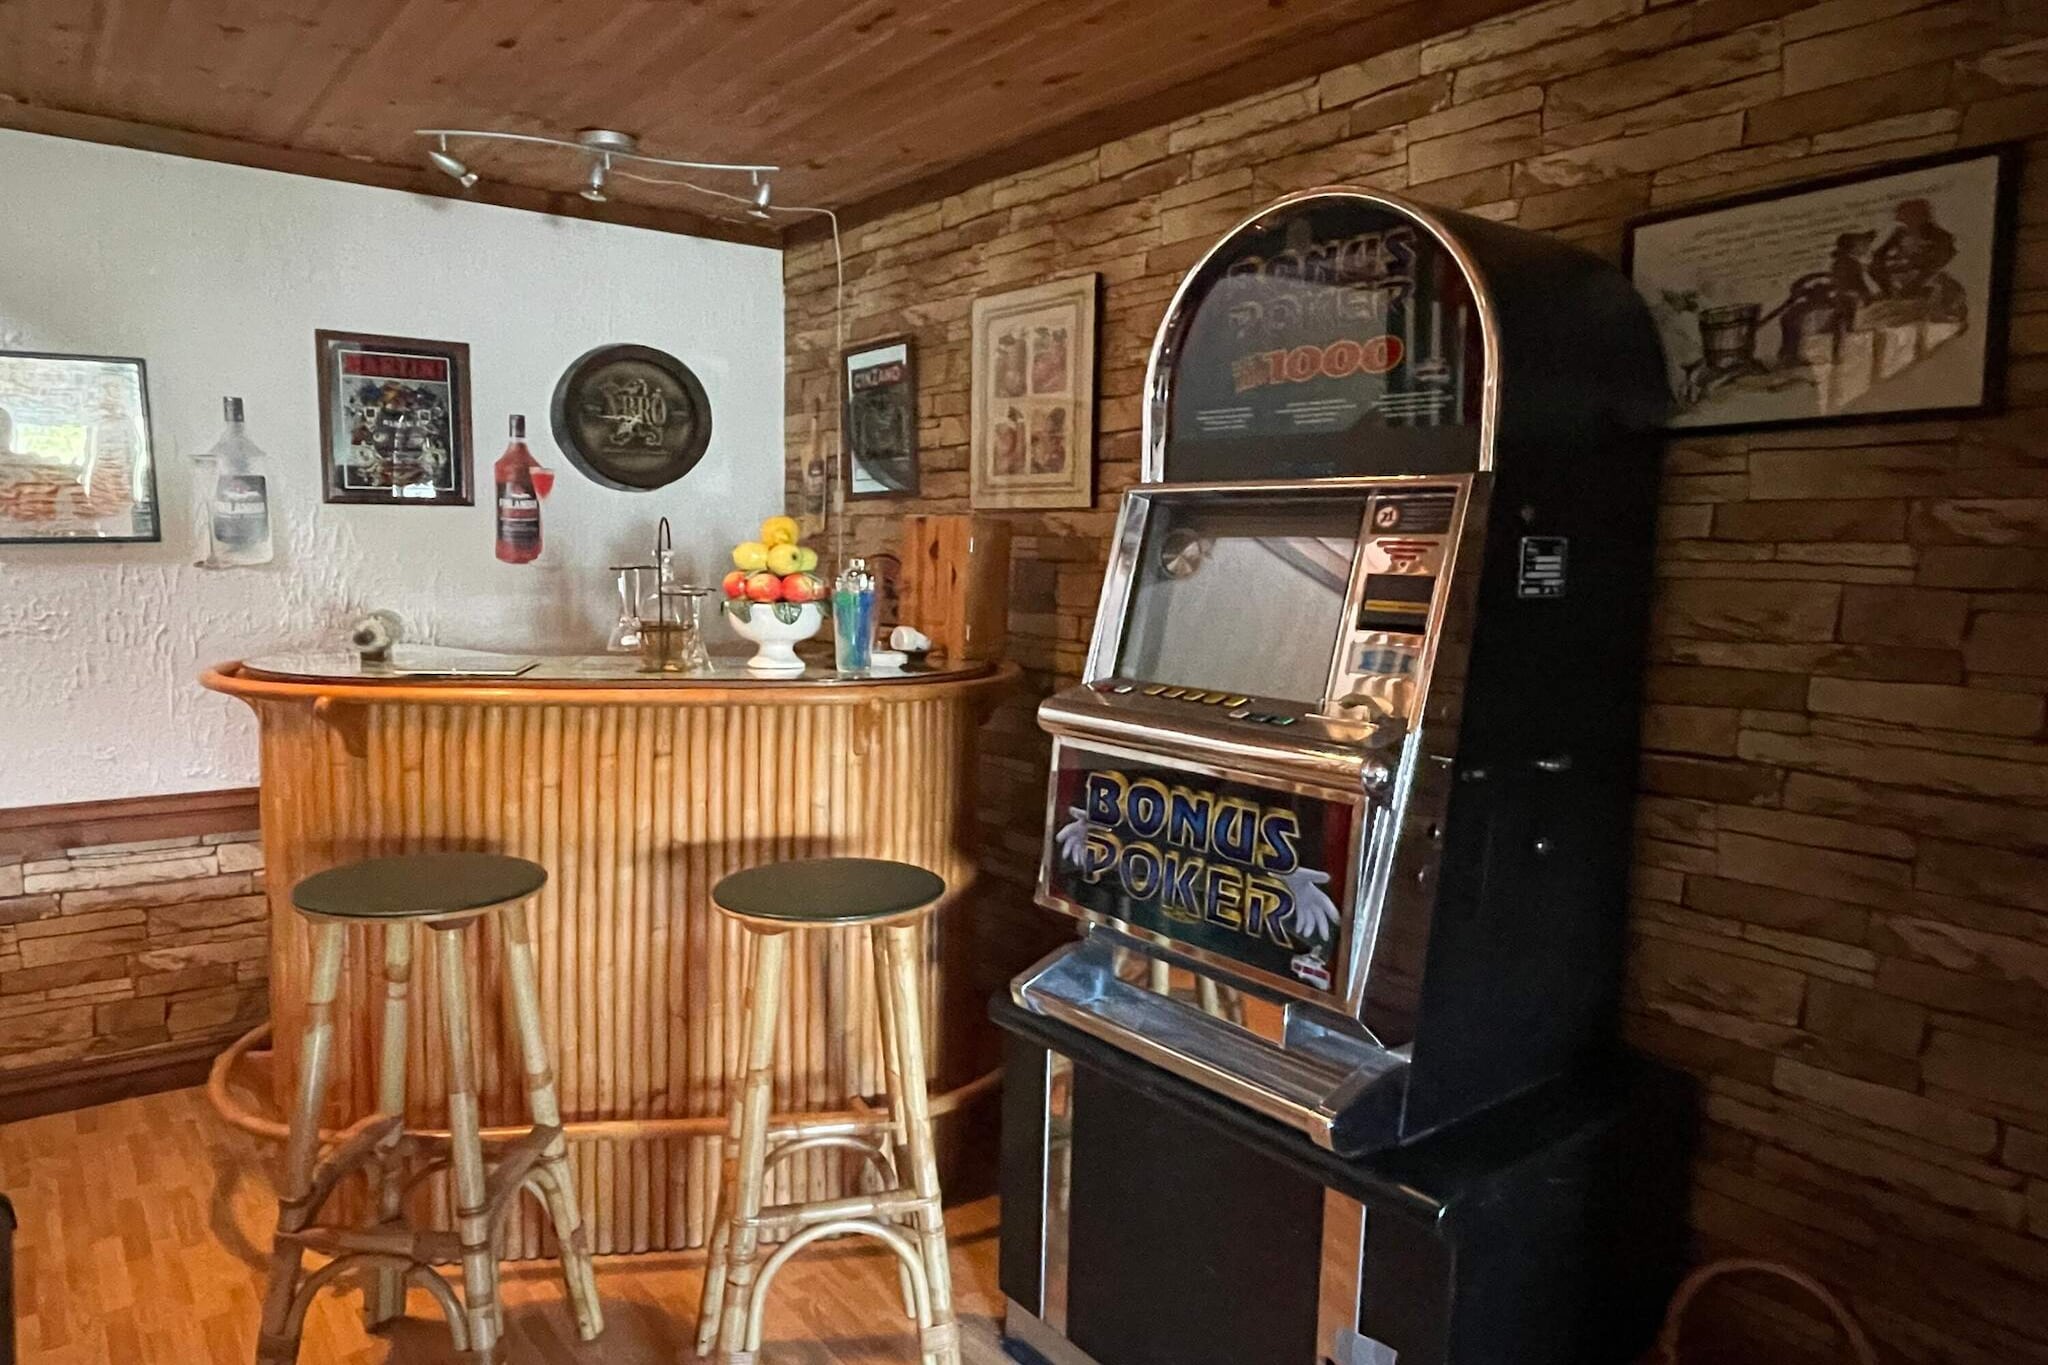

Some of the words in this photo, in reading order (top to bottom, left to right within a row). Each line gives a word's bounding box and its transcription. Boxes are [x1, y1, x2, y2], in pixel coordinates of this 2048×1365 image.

[1262, 334, 1405, 383] 1000
[1085, 769, 1301, 876] BONUS
[1083, 830, 1297, 949] POKER
